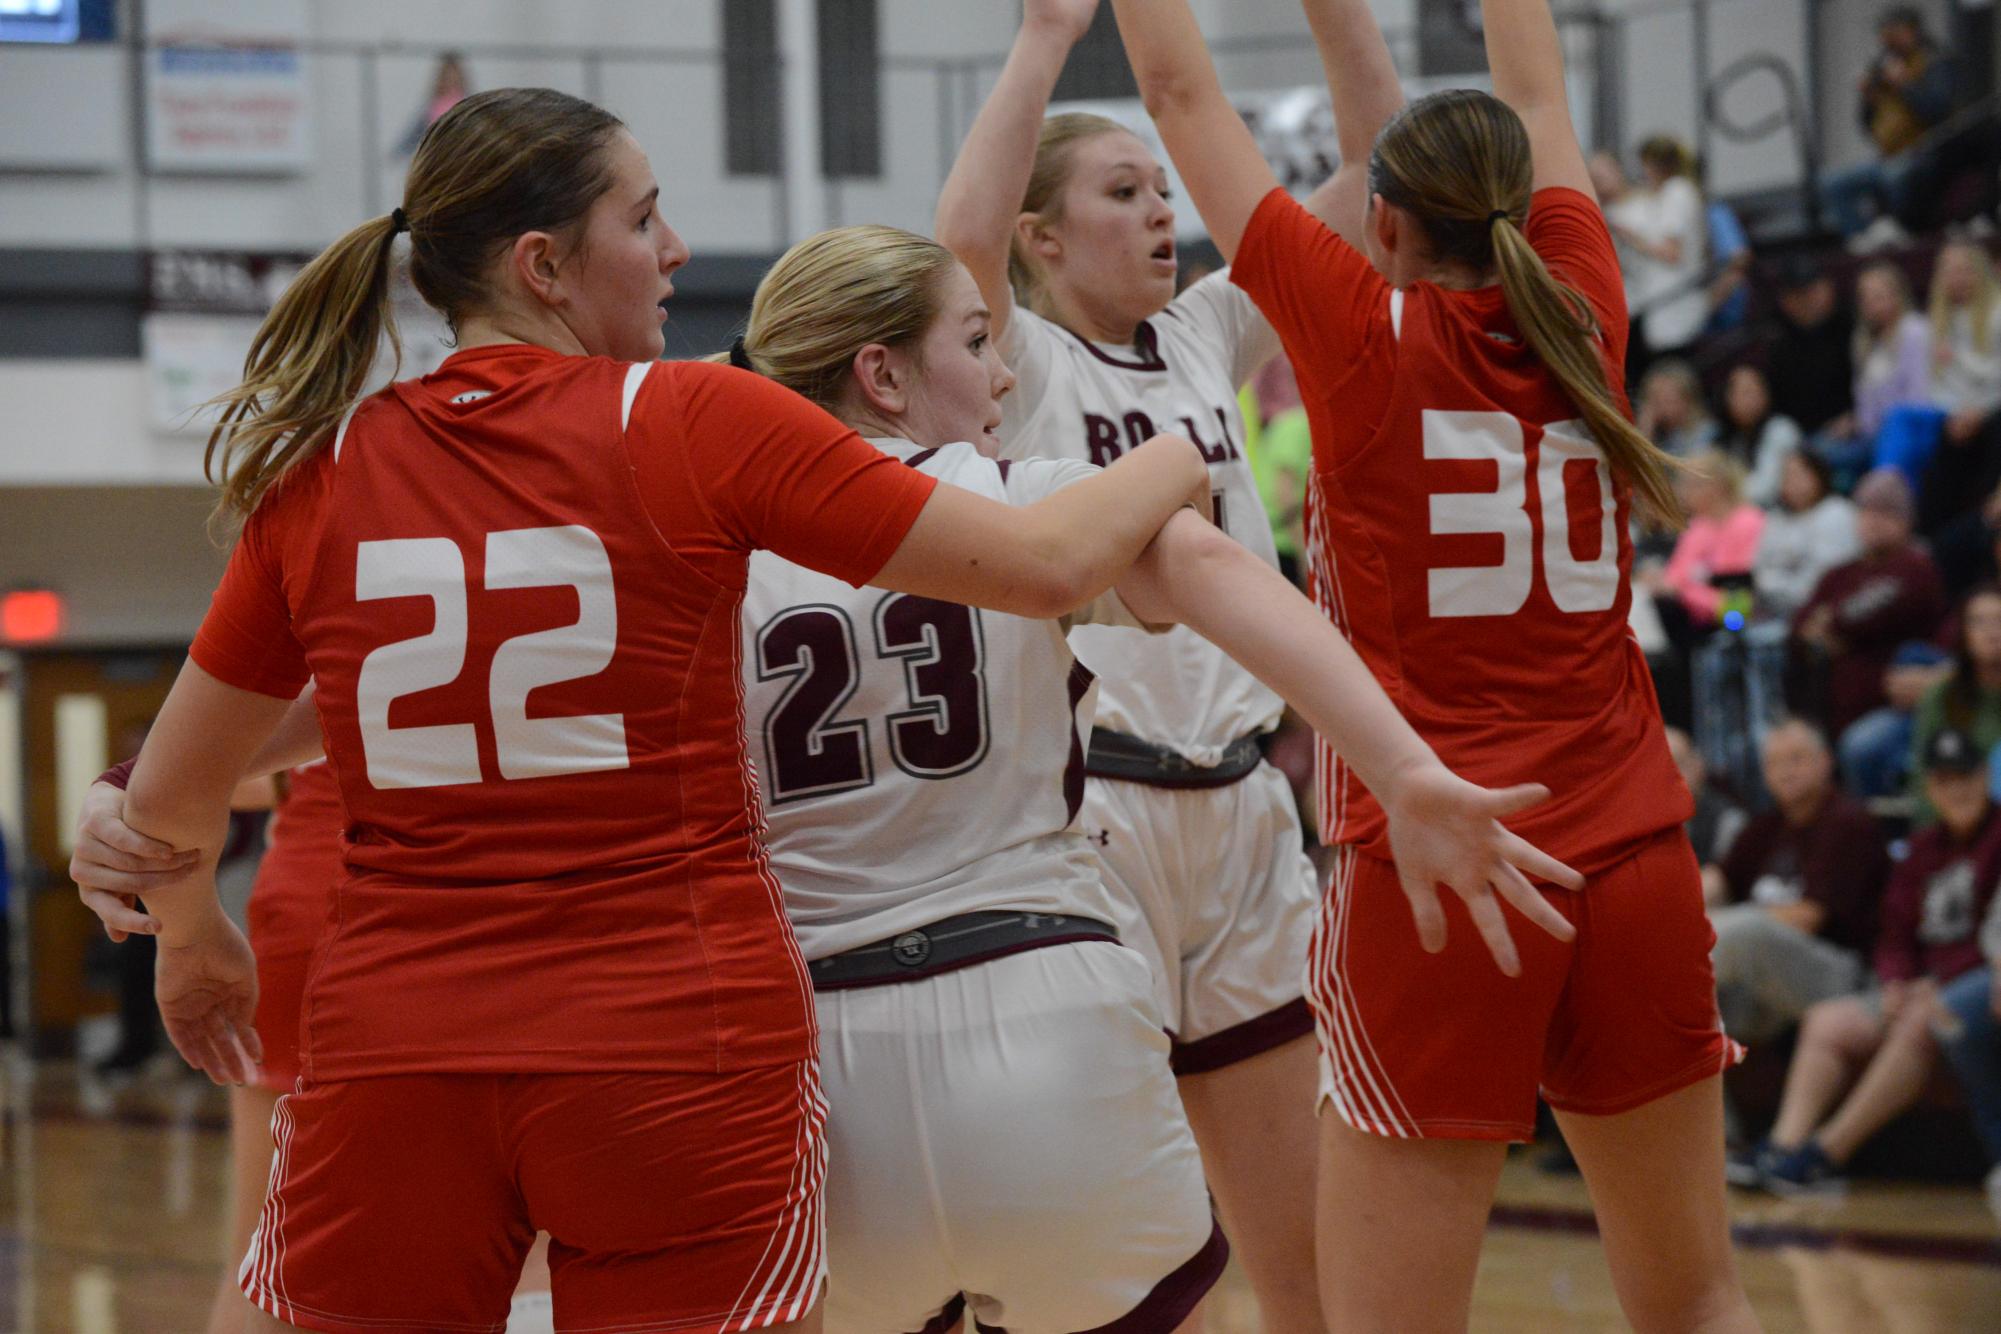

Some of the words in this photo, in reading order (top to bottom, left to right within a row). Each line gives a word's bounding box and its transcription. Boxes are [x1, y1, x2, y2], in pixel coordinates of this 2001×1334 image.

[1421, 408, 1620, 618] 30
[355, 524, 630, 790] 22
[756, 591, 990, 807] 23
